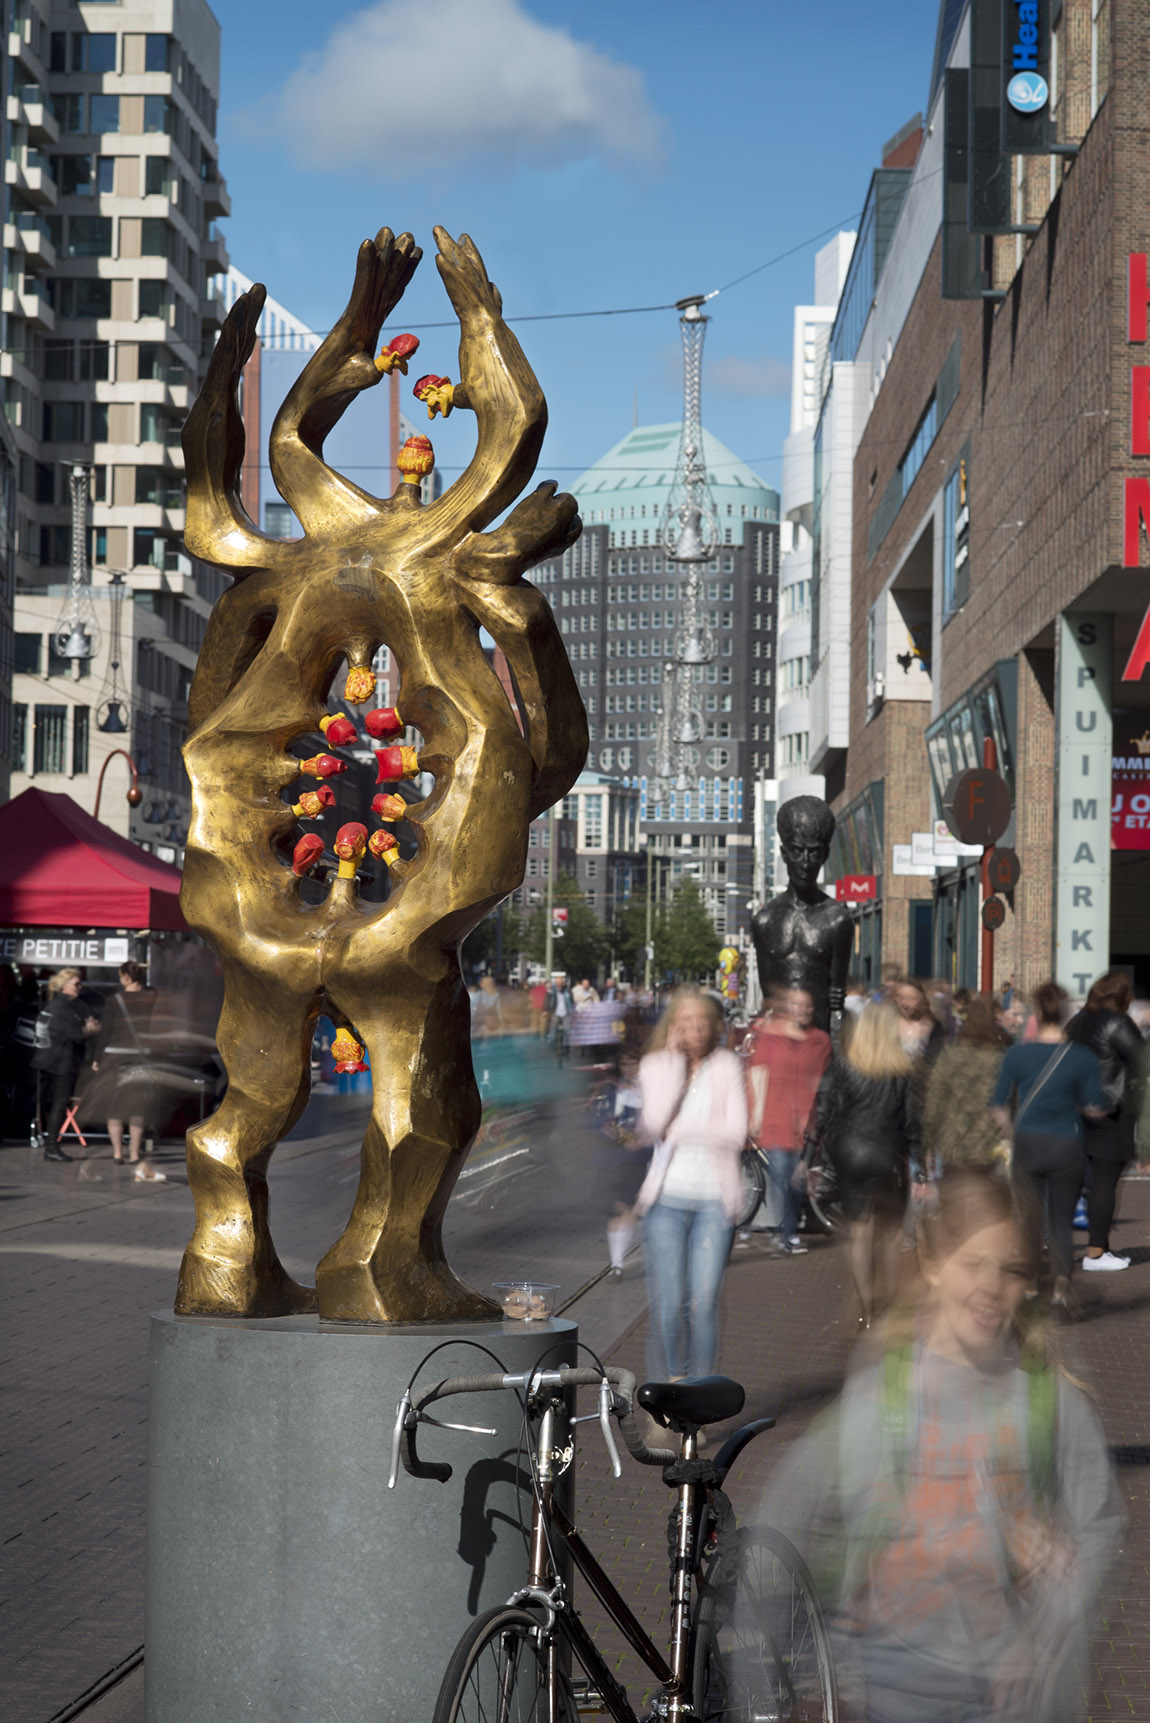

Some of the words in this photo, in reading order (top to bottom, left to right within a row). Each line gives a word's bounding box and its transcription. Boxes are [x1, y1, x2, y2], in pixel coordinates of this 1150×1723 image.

[969, 782, 984, 819] F
[1072, 623, 1098, 995] SPUIMARKT
[0, 938, 16, 957] E
[23, 939, 99, 959] PETITIE
